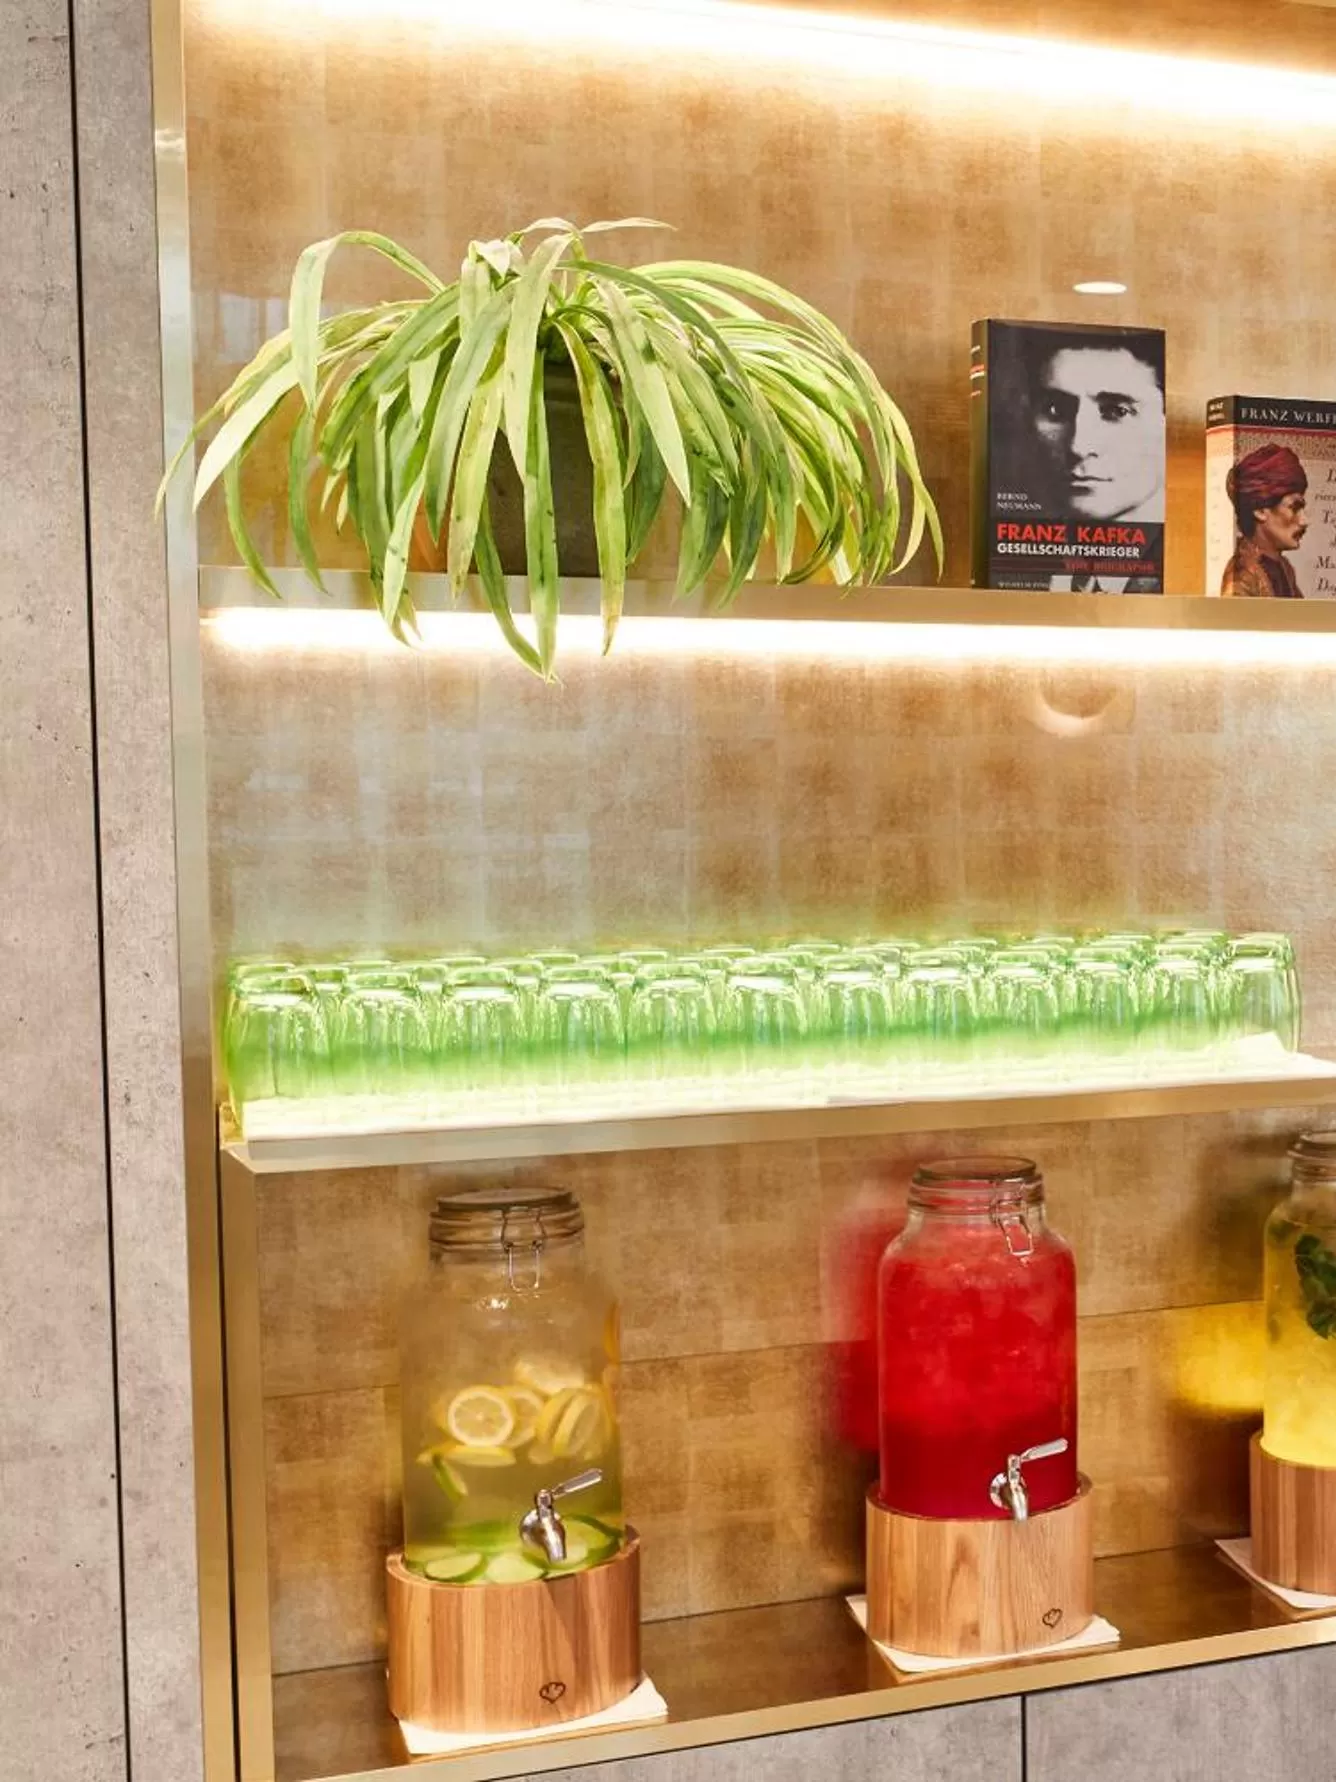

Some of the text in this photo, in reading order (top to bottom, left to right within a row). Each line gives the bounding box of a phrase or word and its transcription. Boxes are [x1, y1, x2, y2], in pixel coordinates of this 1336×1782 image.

[1241, 407, 1288, 421] FRANZ
[997, 523, 1146, 545] FRANZ KAFKA
[997, 543, 1140, 558] GESELLSCHAFTSKRIEGER
